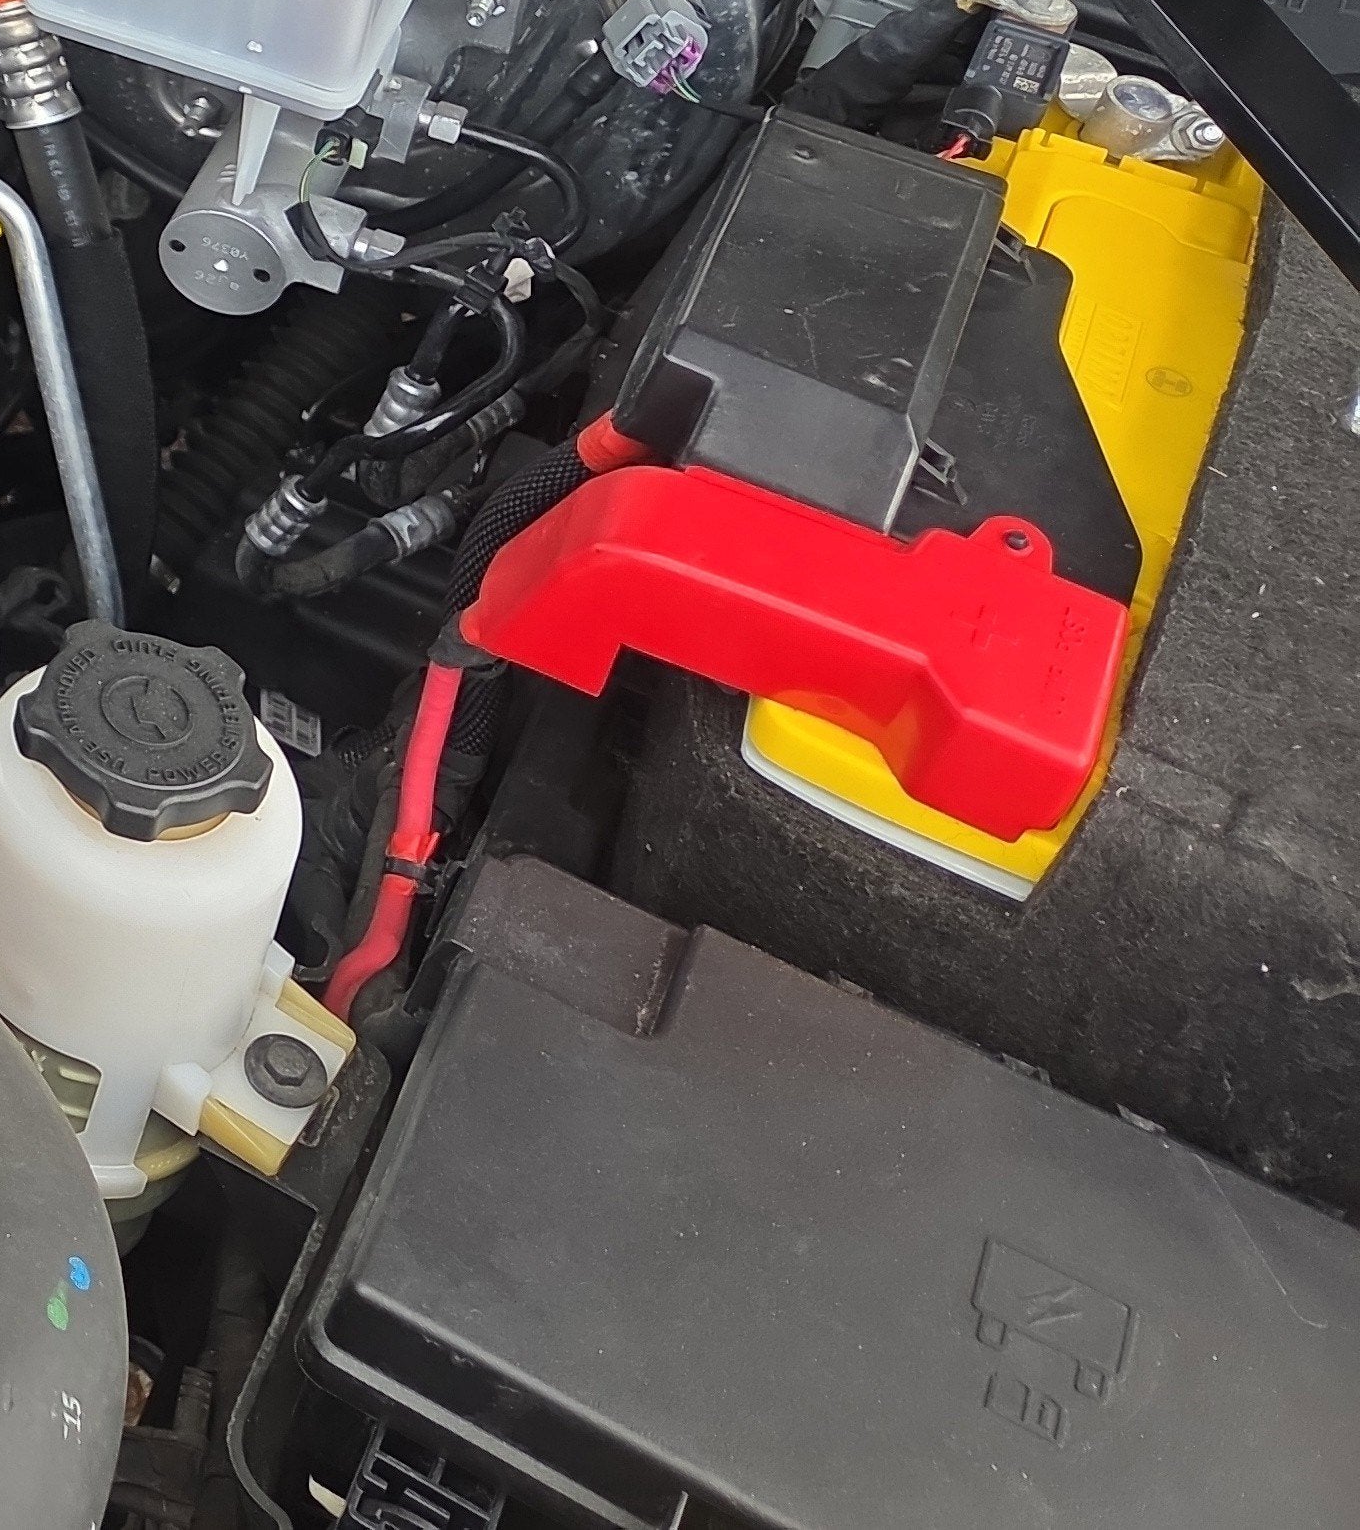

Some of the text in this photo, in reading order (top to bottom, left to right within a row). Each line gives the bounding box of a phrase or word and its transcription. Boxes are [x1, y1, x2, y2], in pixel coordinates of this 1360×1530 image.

[56, 647, 98, 735] APPROVED
[111, 639, 242, 783] POWER STEERING FLUID
